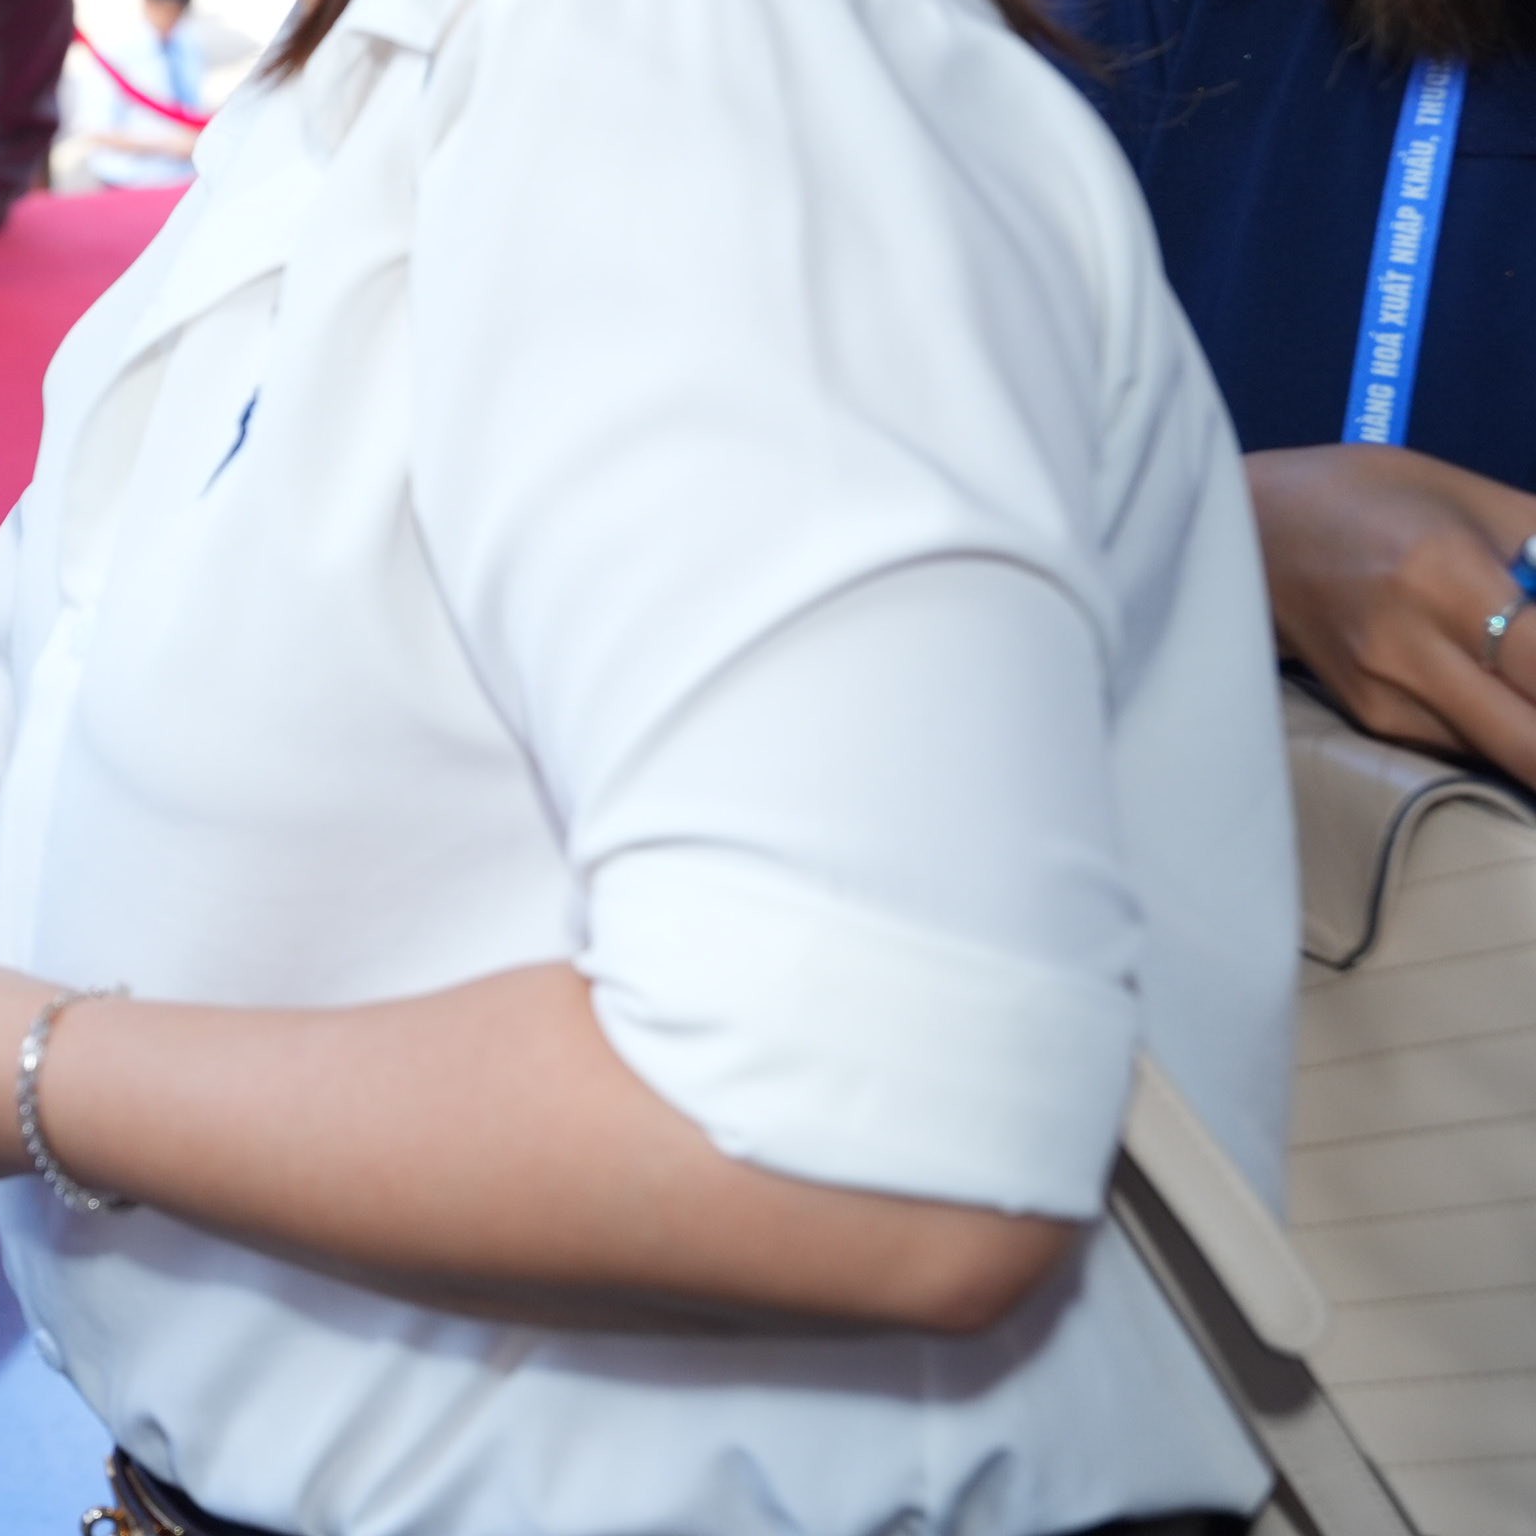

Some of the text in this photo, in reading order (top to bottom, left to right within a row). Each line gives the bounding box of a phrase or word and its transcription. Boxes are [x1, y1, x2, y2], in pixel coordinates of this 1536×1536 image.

[1356, 135, 1440, 445] HÀNG HOÁ XUẤT NHẬP KHẨU,
